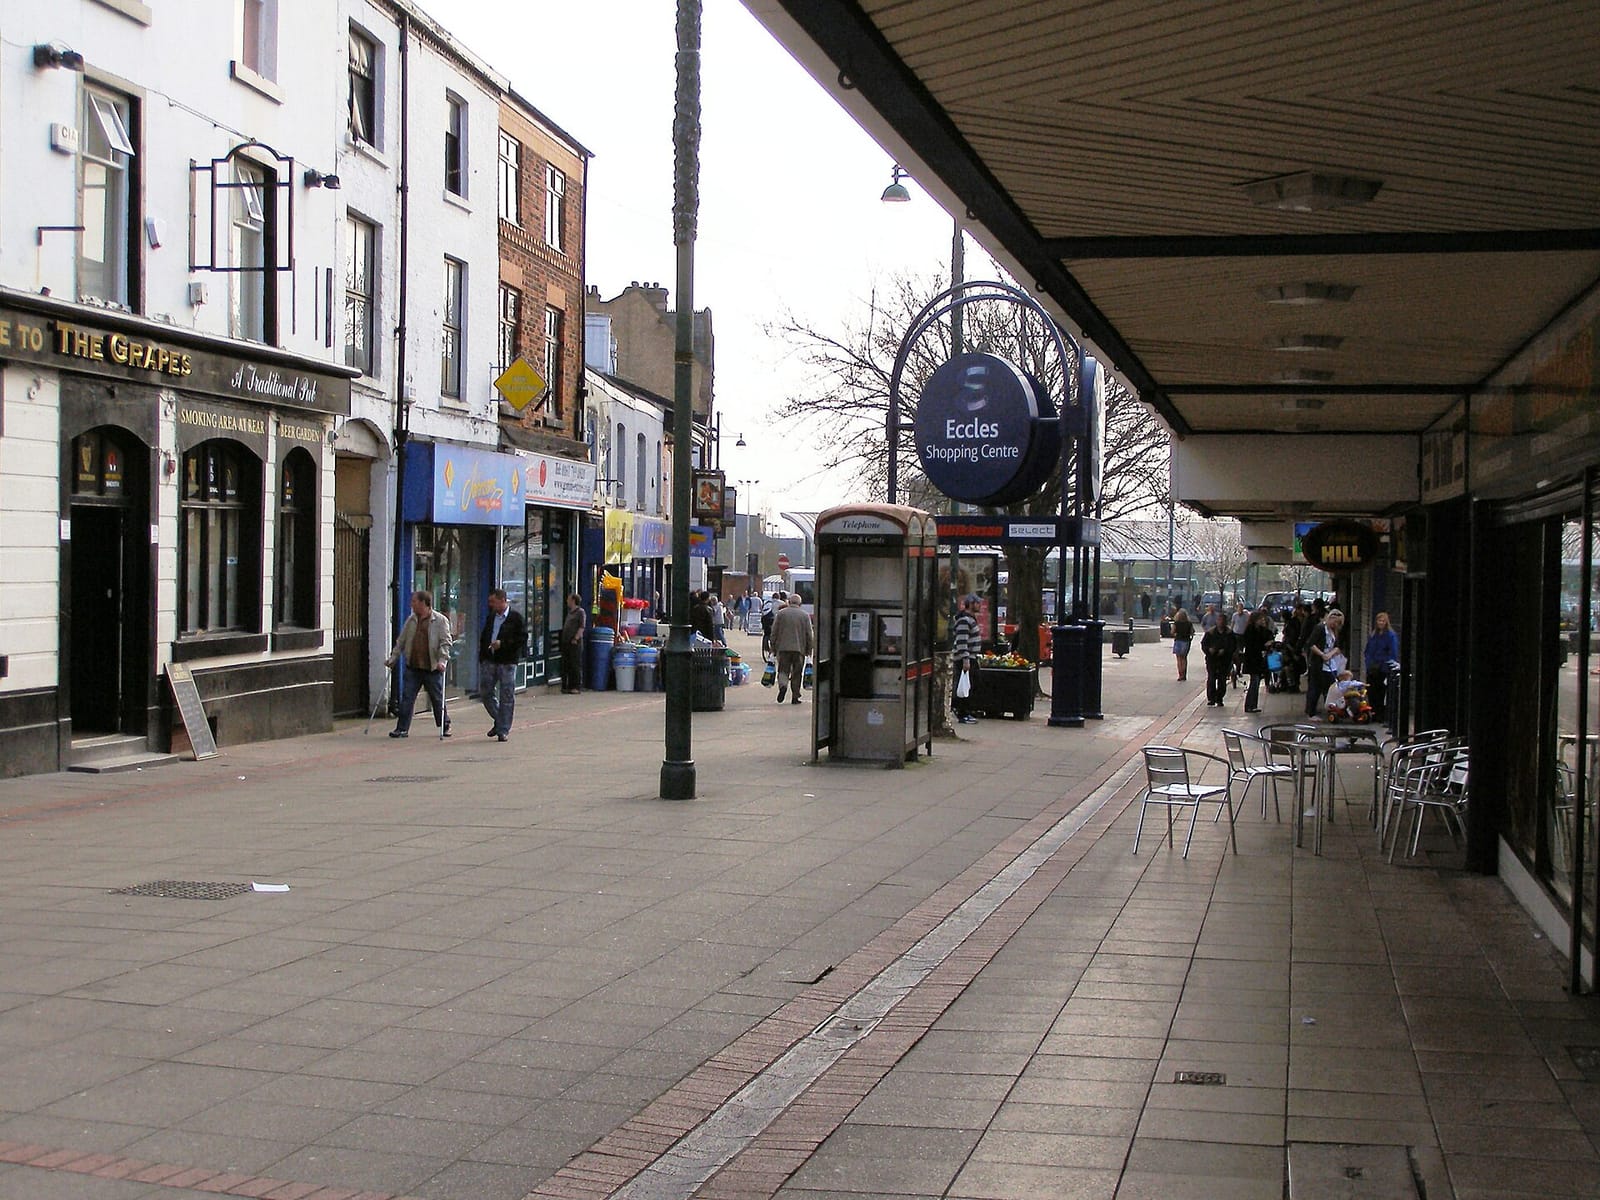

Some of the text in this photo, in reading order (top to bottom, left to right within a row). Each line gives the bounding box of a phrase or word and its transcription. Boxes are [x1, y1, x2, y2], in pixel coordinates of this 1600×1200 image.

[17, 324, 43, 352] TO
[54, 320, 104, 361] THE
[108, 332, 192, 377] GRAPES
[231, 363, 244, 389] A
[247, 364, 299, 400] Traditional
[180, 408, 265, 434] SMOKING AREA AT REAR
[946, 417, 999, 440] Eccles
[280, 423, 320, 443] BEER GARDEN
[926, 444, 1019, 463] Shopping Centre
[842, 520, 880, 530] Telephone
[1321, 544, 1362, 563] HILL
